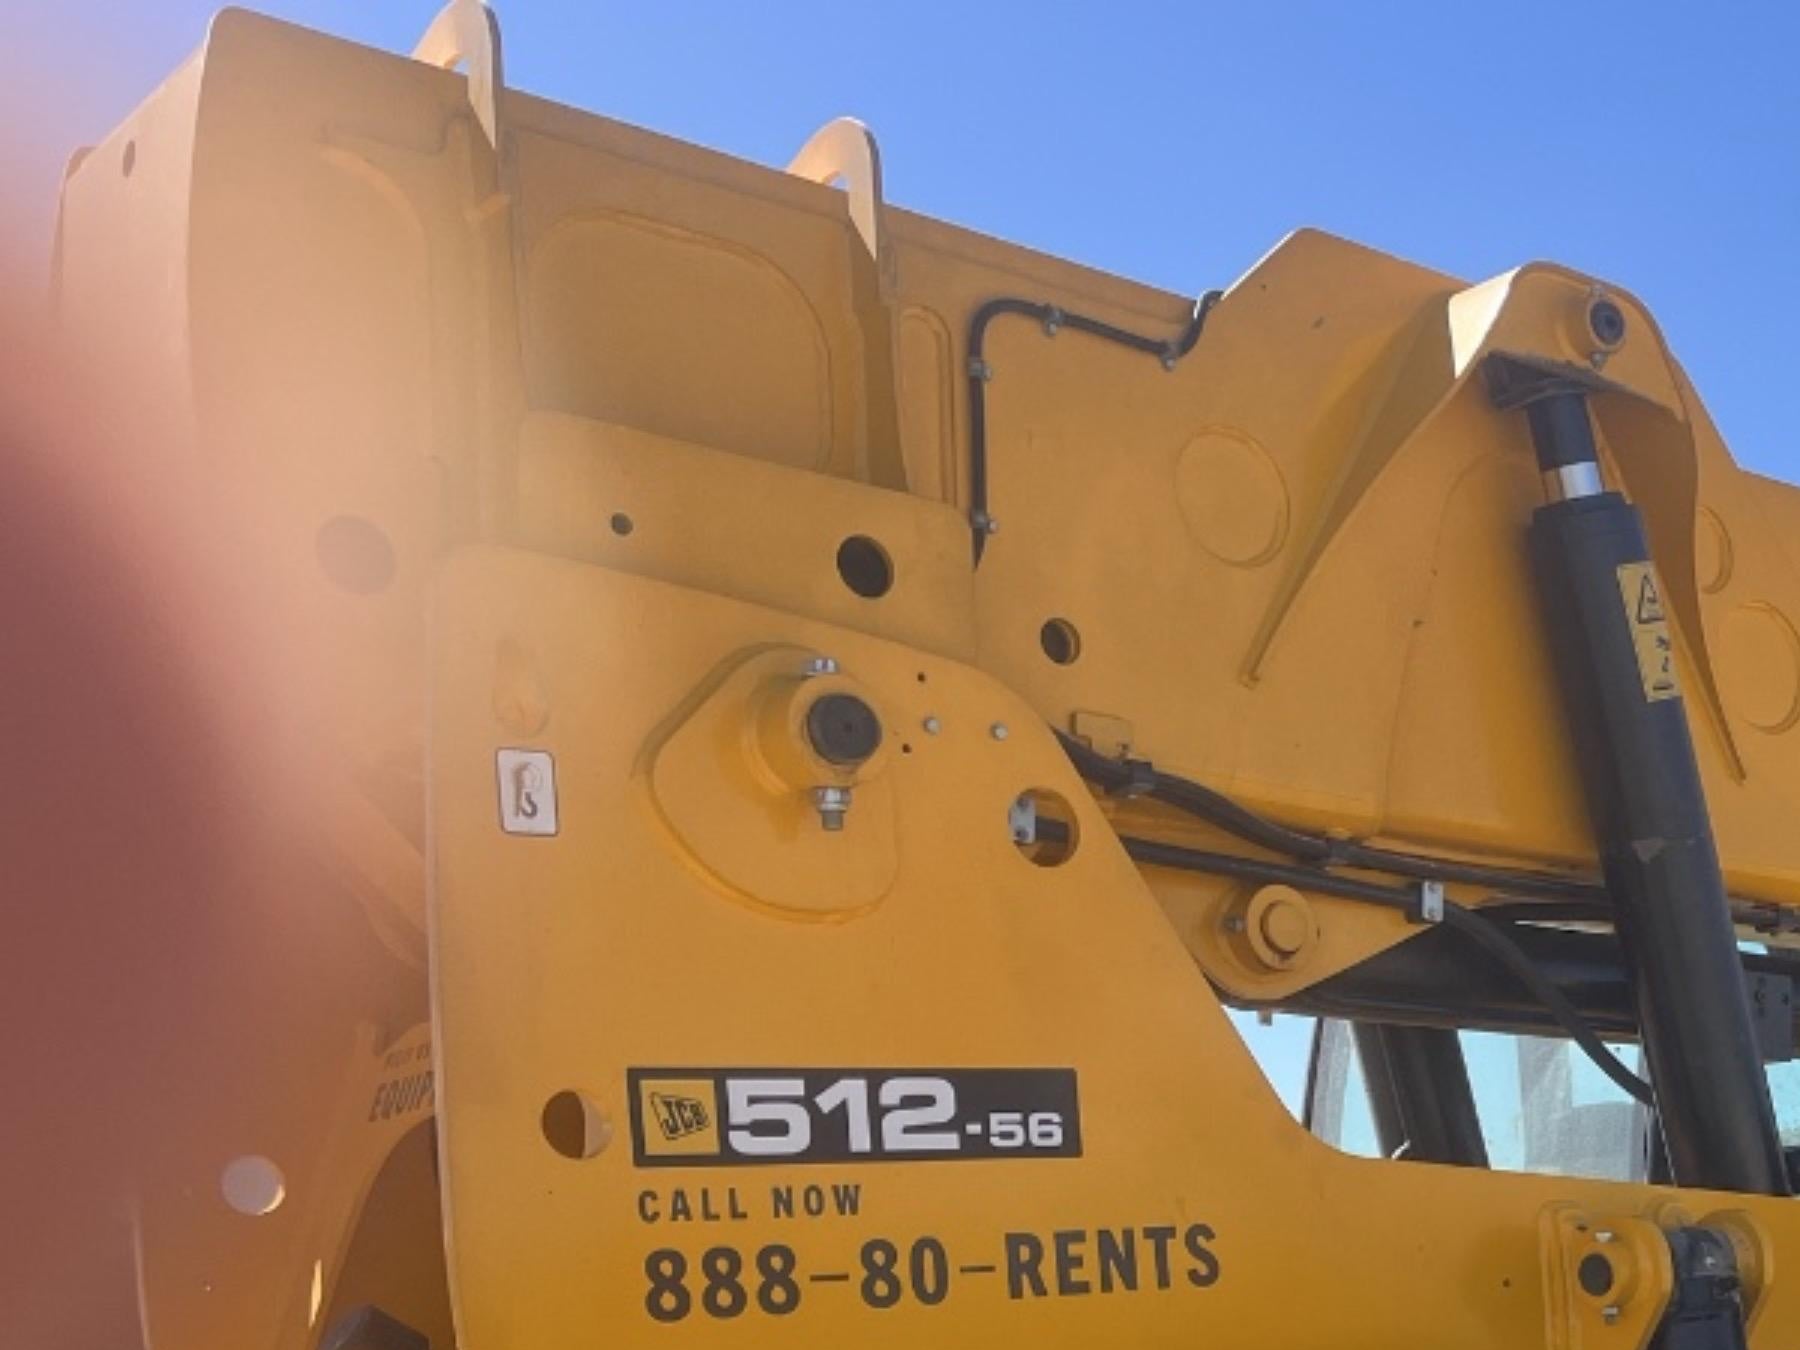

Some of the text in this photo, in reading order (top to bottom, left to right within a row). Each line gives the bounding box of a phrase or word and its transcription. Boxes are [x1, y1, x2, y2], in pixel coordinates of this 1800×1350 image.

[653, 1076, 1064, 1156] JCB 512-56
[638, 1184, 862, 1223] CALL NOW
[643, 1223, 1220, 1323] 888-80-RENTS
